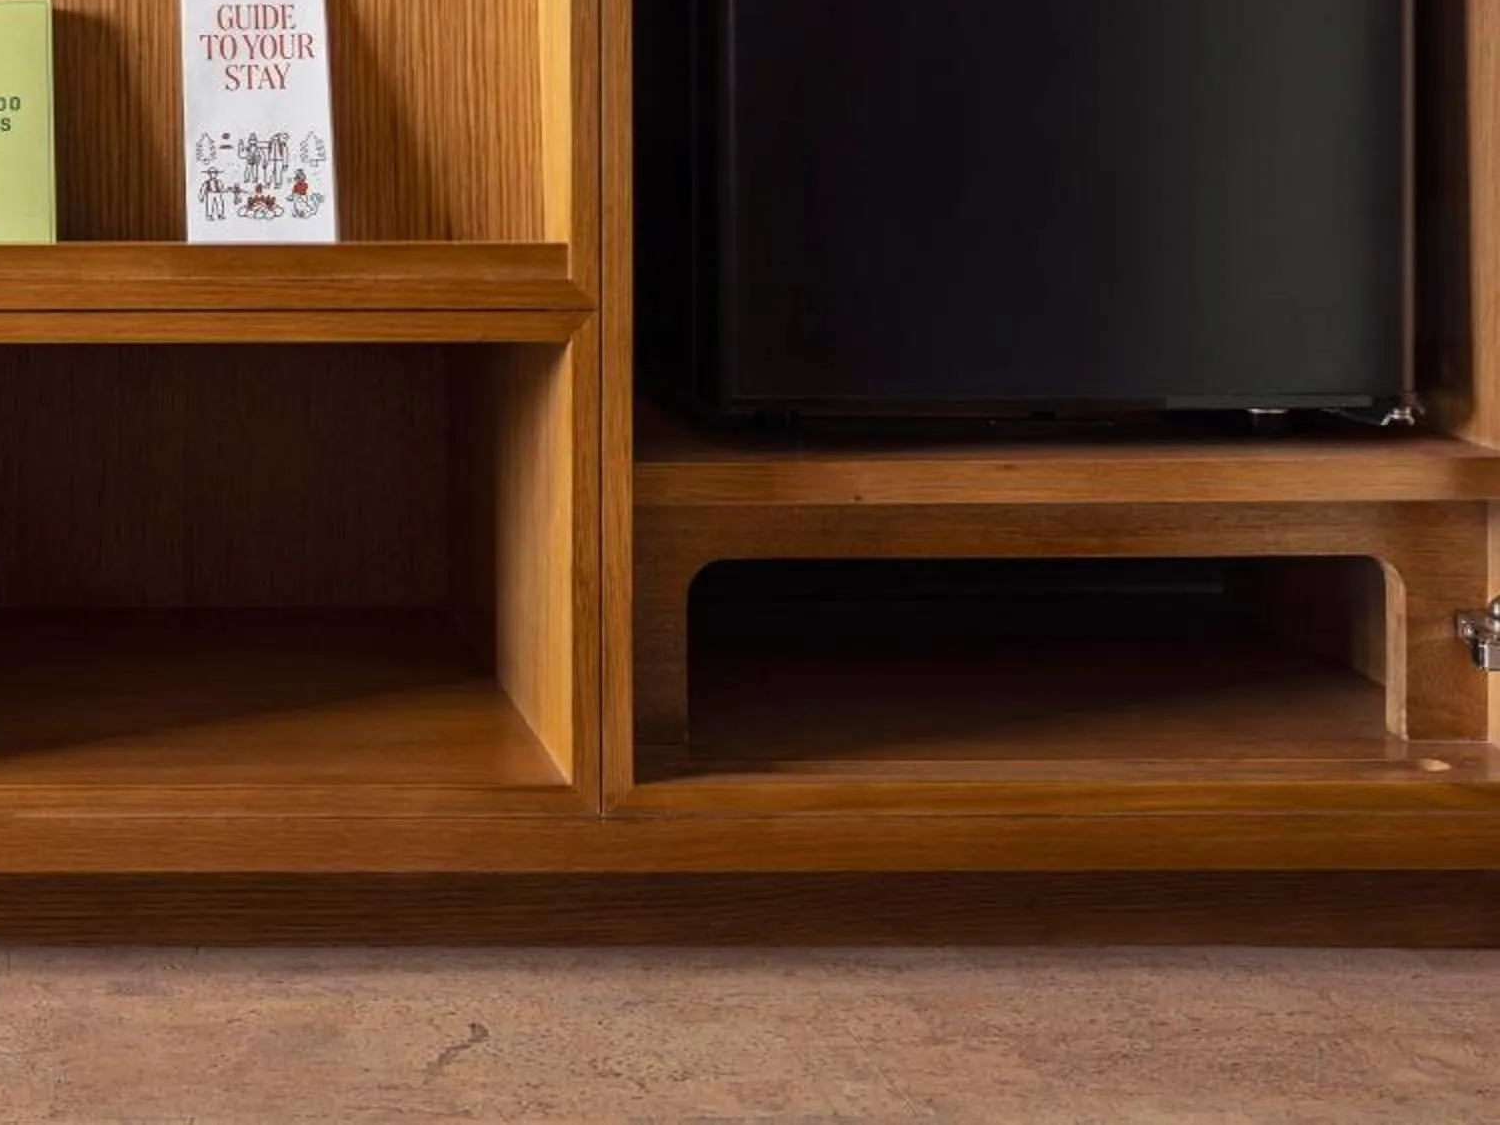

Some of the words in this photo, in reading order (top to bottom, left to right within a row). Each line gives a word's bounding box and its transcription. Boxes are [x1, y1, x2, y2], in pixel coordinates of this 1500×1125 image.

[216, 3, 297, 31] GUIDE
[199, 34, 238, 61] TO
[242, 33, 315, 60] YOUR
[224, 63, 291, 91] STAY
